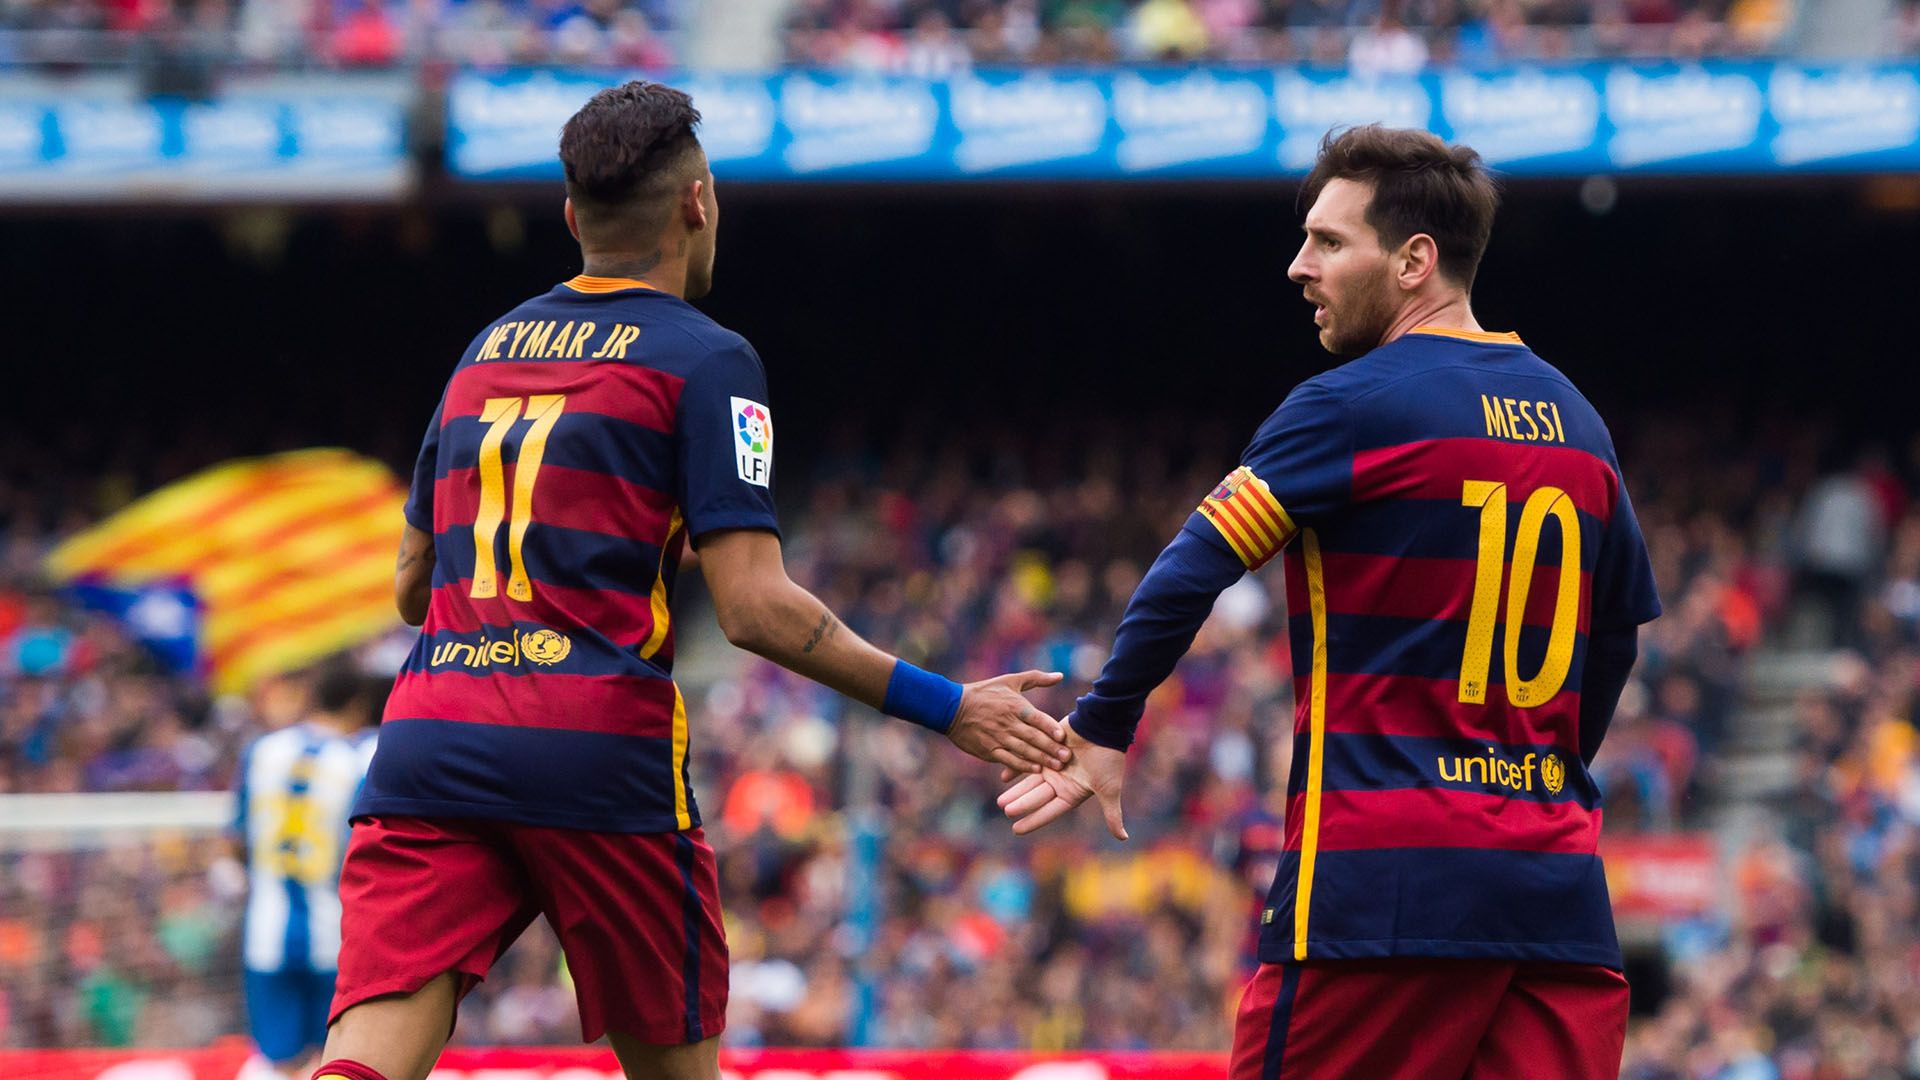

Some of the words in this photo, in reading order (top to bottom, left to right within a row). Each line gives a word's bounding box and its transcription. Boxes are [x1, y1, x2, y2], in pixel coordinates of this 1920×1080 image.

[475, 320, 596, 362] NEYMAR
[592, 323, 641, 359] JR
[1481, 394, 1565, 443] MESSI
[742, 455, 767, 483] LF
[470, 394, 567, 602] 11
[1458, 480, 1581, 708] 10
[1437, 747, 1536, 791] unicef
